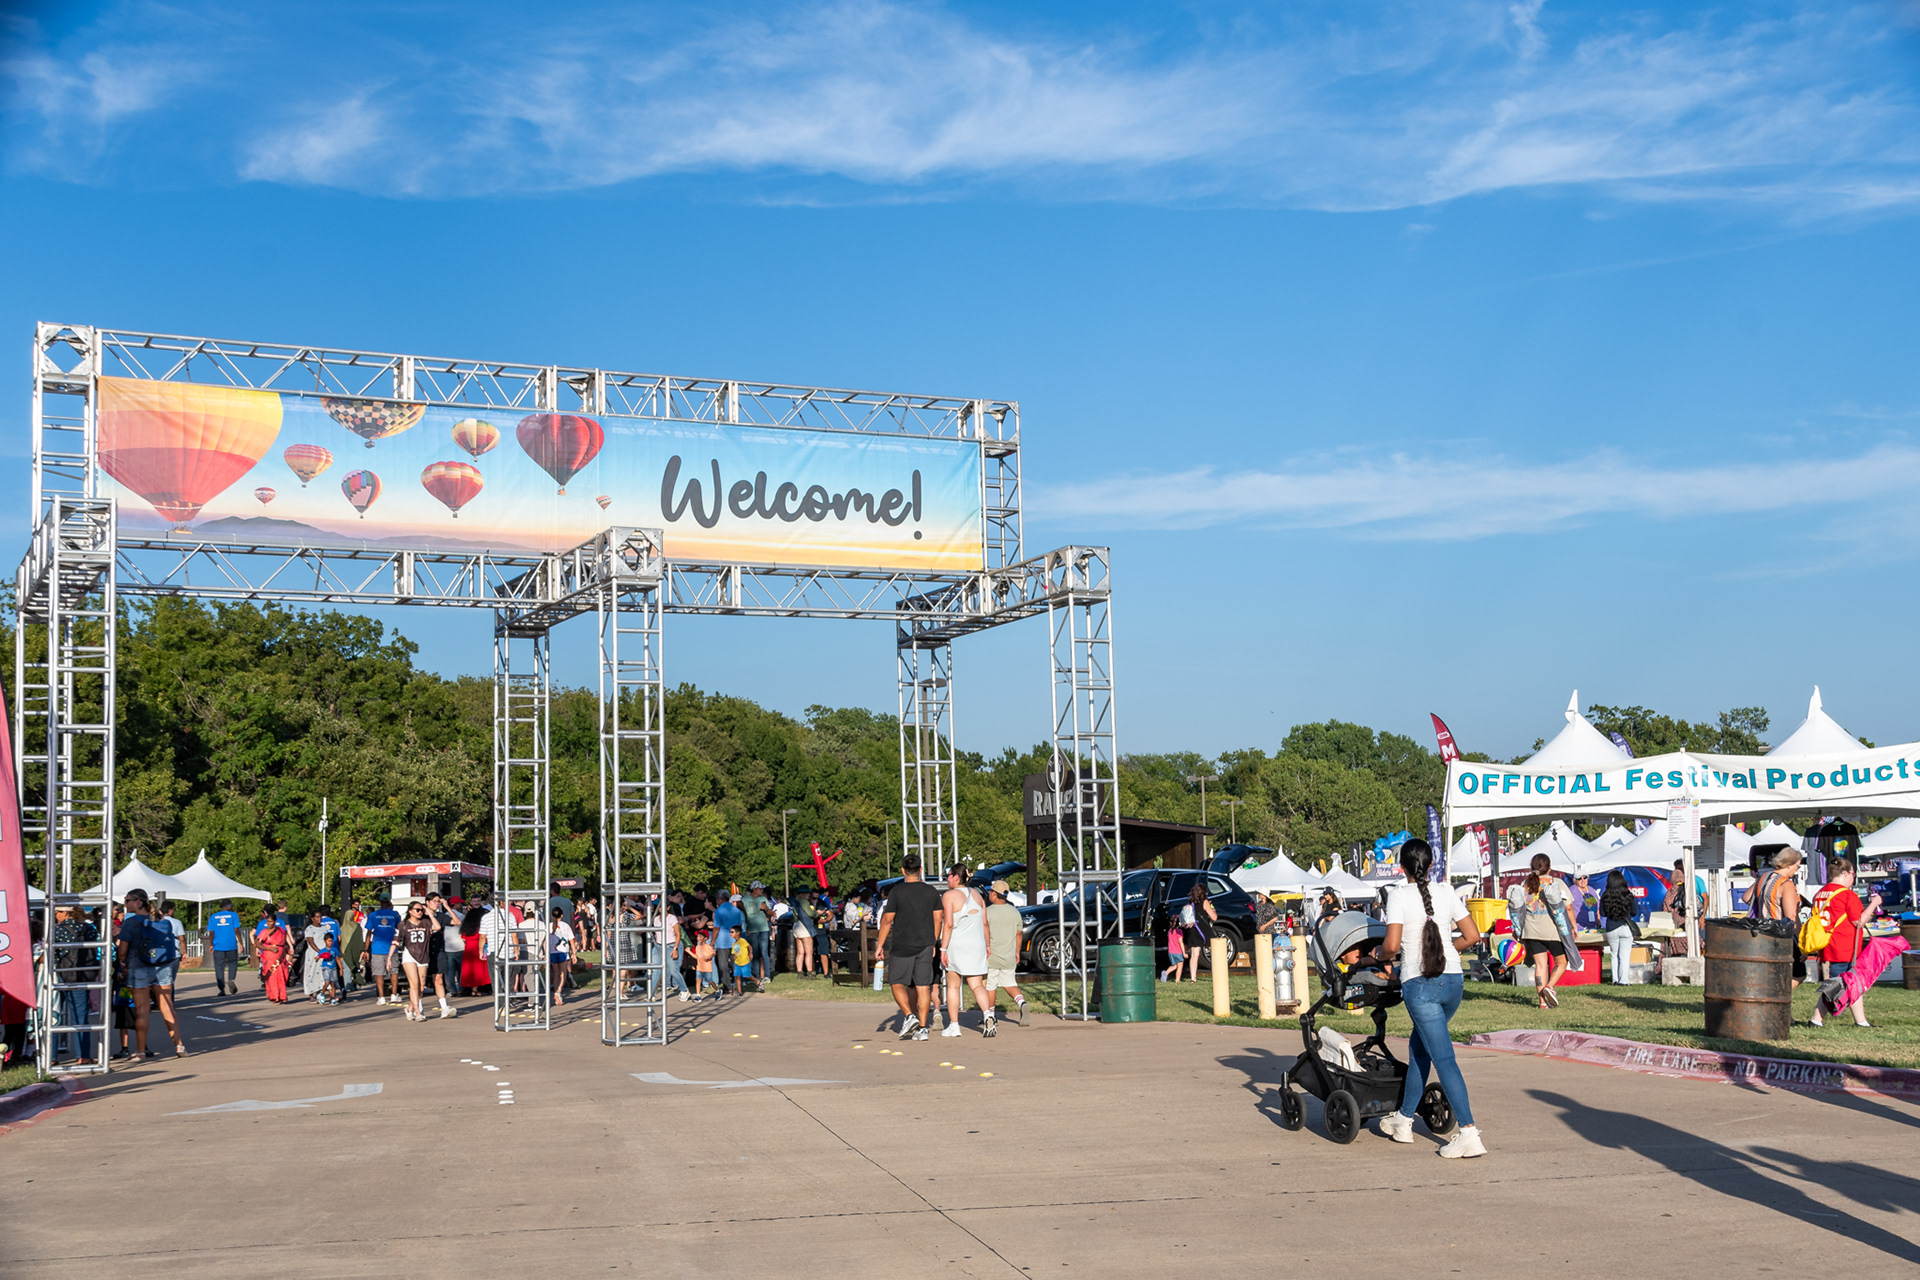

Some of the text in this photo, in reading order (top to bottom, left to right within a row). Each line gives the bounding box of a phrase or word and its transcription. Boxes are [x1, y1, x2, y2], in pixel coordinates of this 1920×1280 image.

[661, 455, 922, 540] Welcome!
[1458, 771, 1611, 795] OFFICIAL
[1626, 764, 1757, 790] Festival
[410, 930, 425, 943] 23
[1624, 1046, 1654, 1066] FIRE
[1661, 1051, 1700, 1072] LANE
[1733, 1060, 1757, 1078] NO
